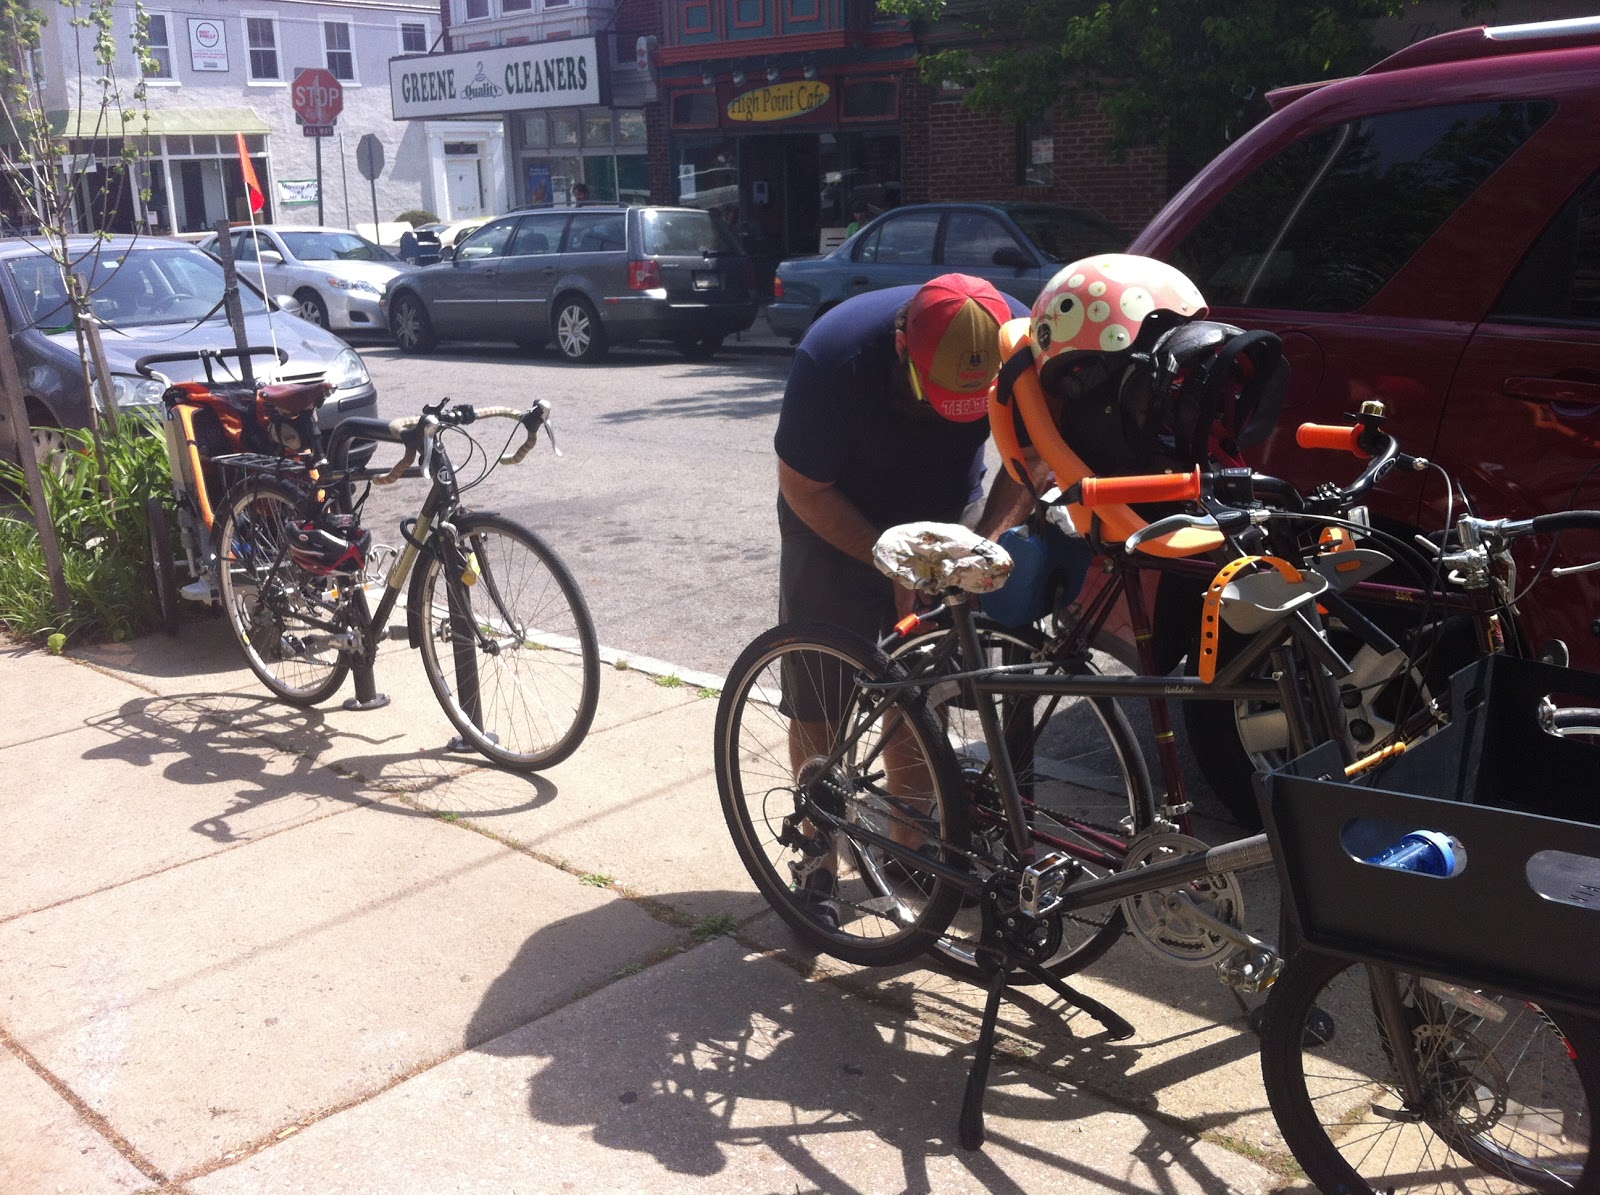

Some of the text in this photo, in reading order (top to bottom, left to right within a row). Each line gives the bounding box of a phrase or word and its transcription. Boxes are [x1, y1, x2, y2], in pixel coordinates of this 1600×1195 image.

[401, 55, 587, 103] GREENE Quality CLEANERS
[295, 85, 339, 107] STOP
[731, 92, 759, 120] High
[763, 87, 793, 112] Point
[305, 127, 332, 135] ALL WAY
[941, 397, 989, 415] TECATE
